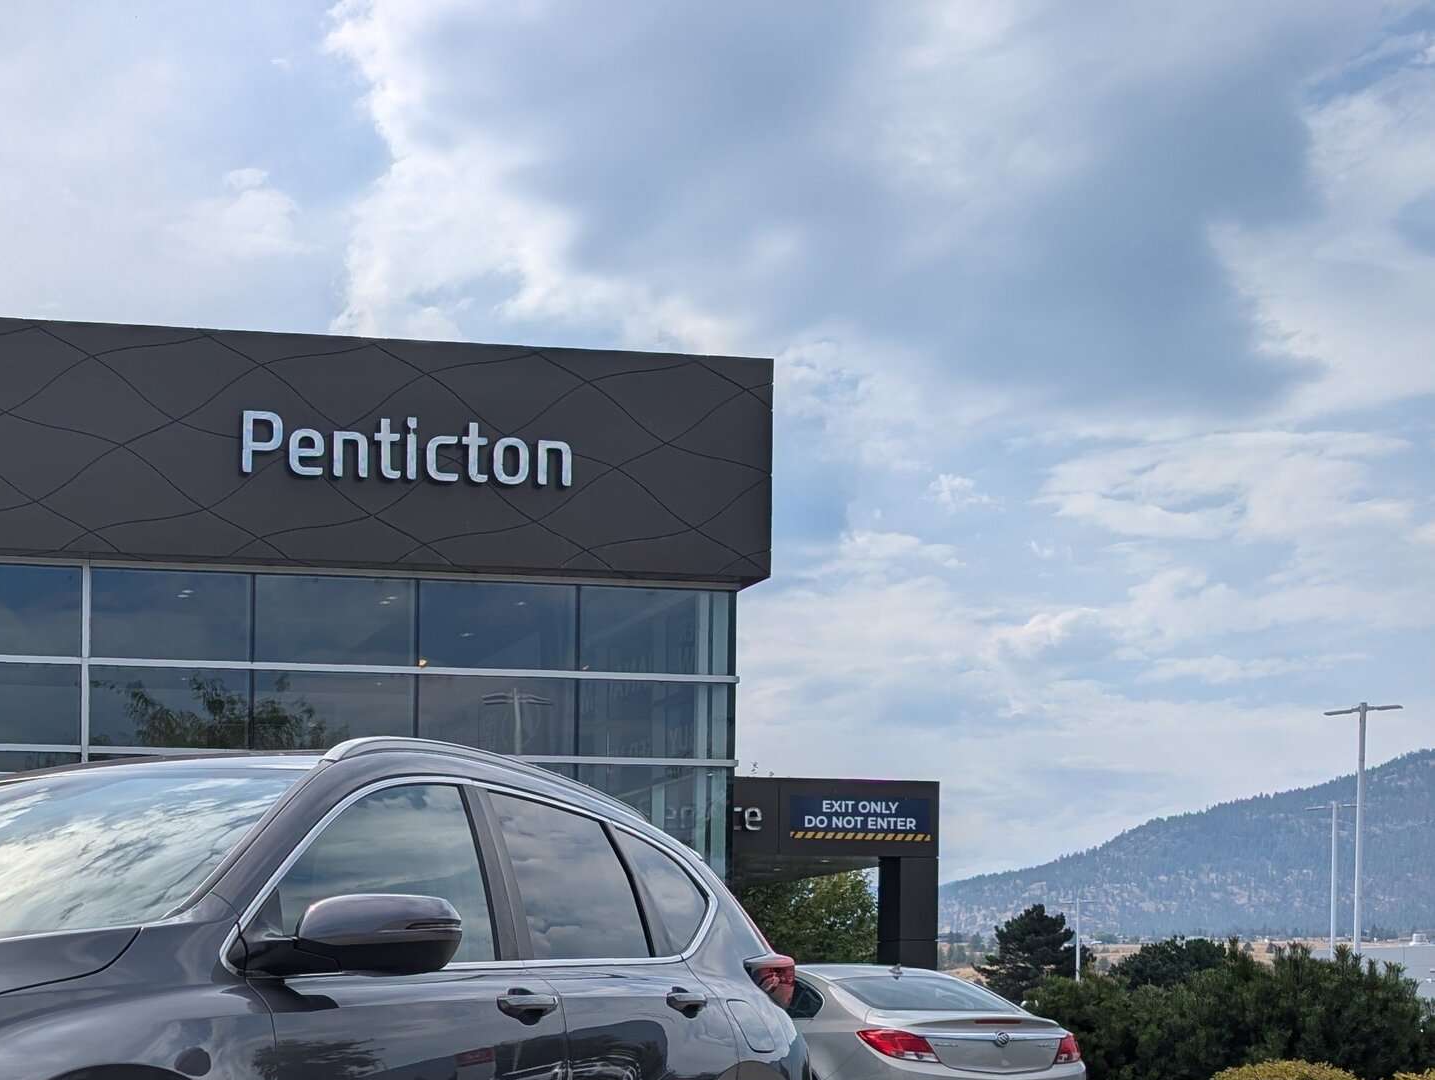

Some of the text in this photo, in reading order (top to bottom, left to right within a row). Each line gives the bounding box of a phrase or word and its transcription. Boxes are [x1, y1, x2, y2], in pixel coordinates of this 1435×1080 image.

[241, 409, 573, 487] Penticton
[821, 799, 899, 814] EXIT ONLY
[804, 815, 917, 831] DO NOT ENTER
